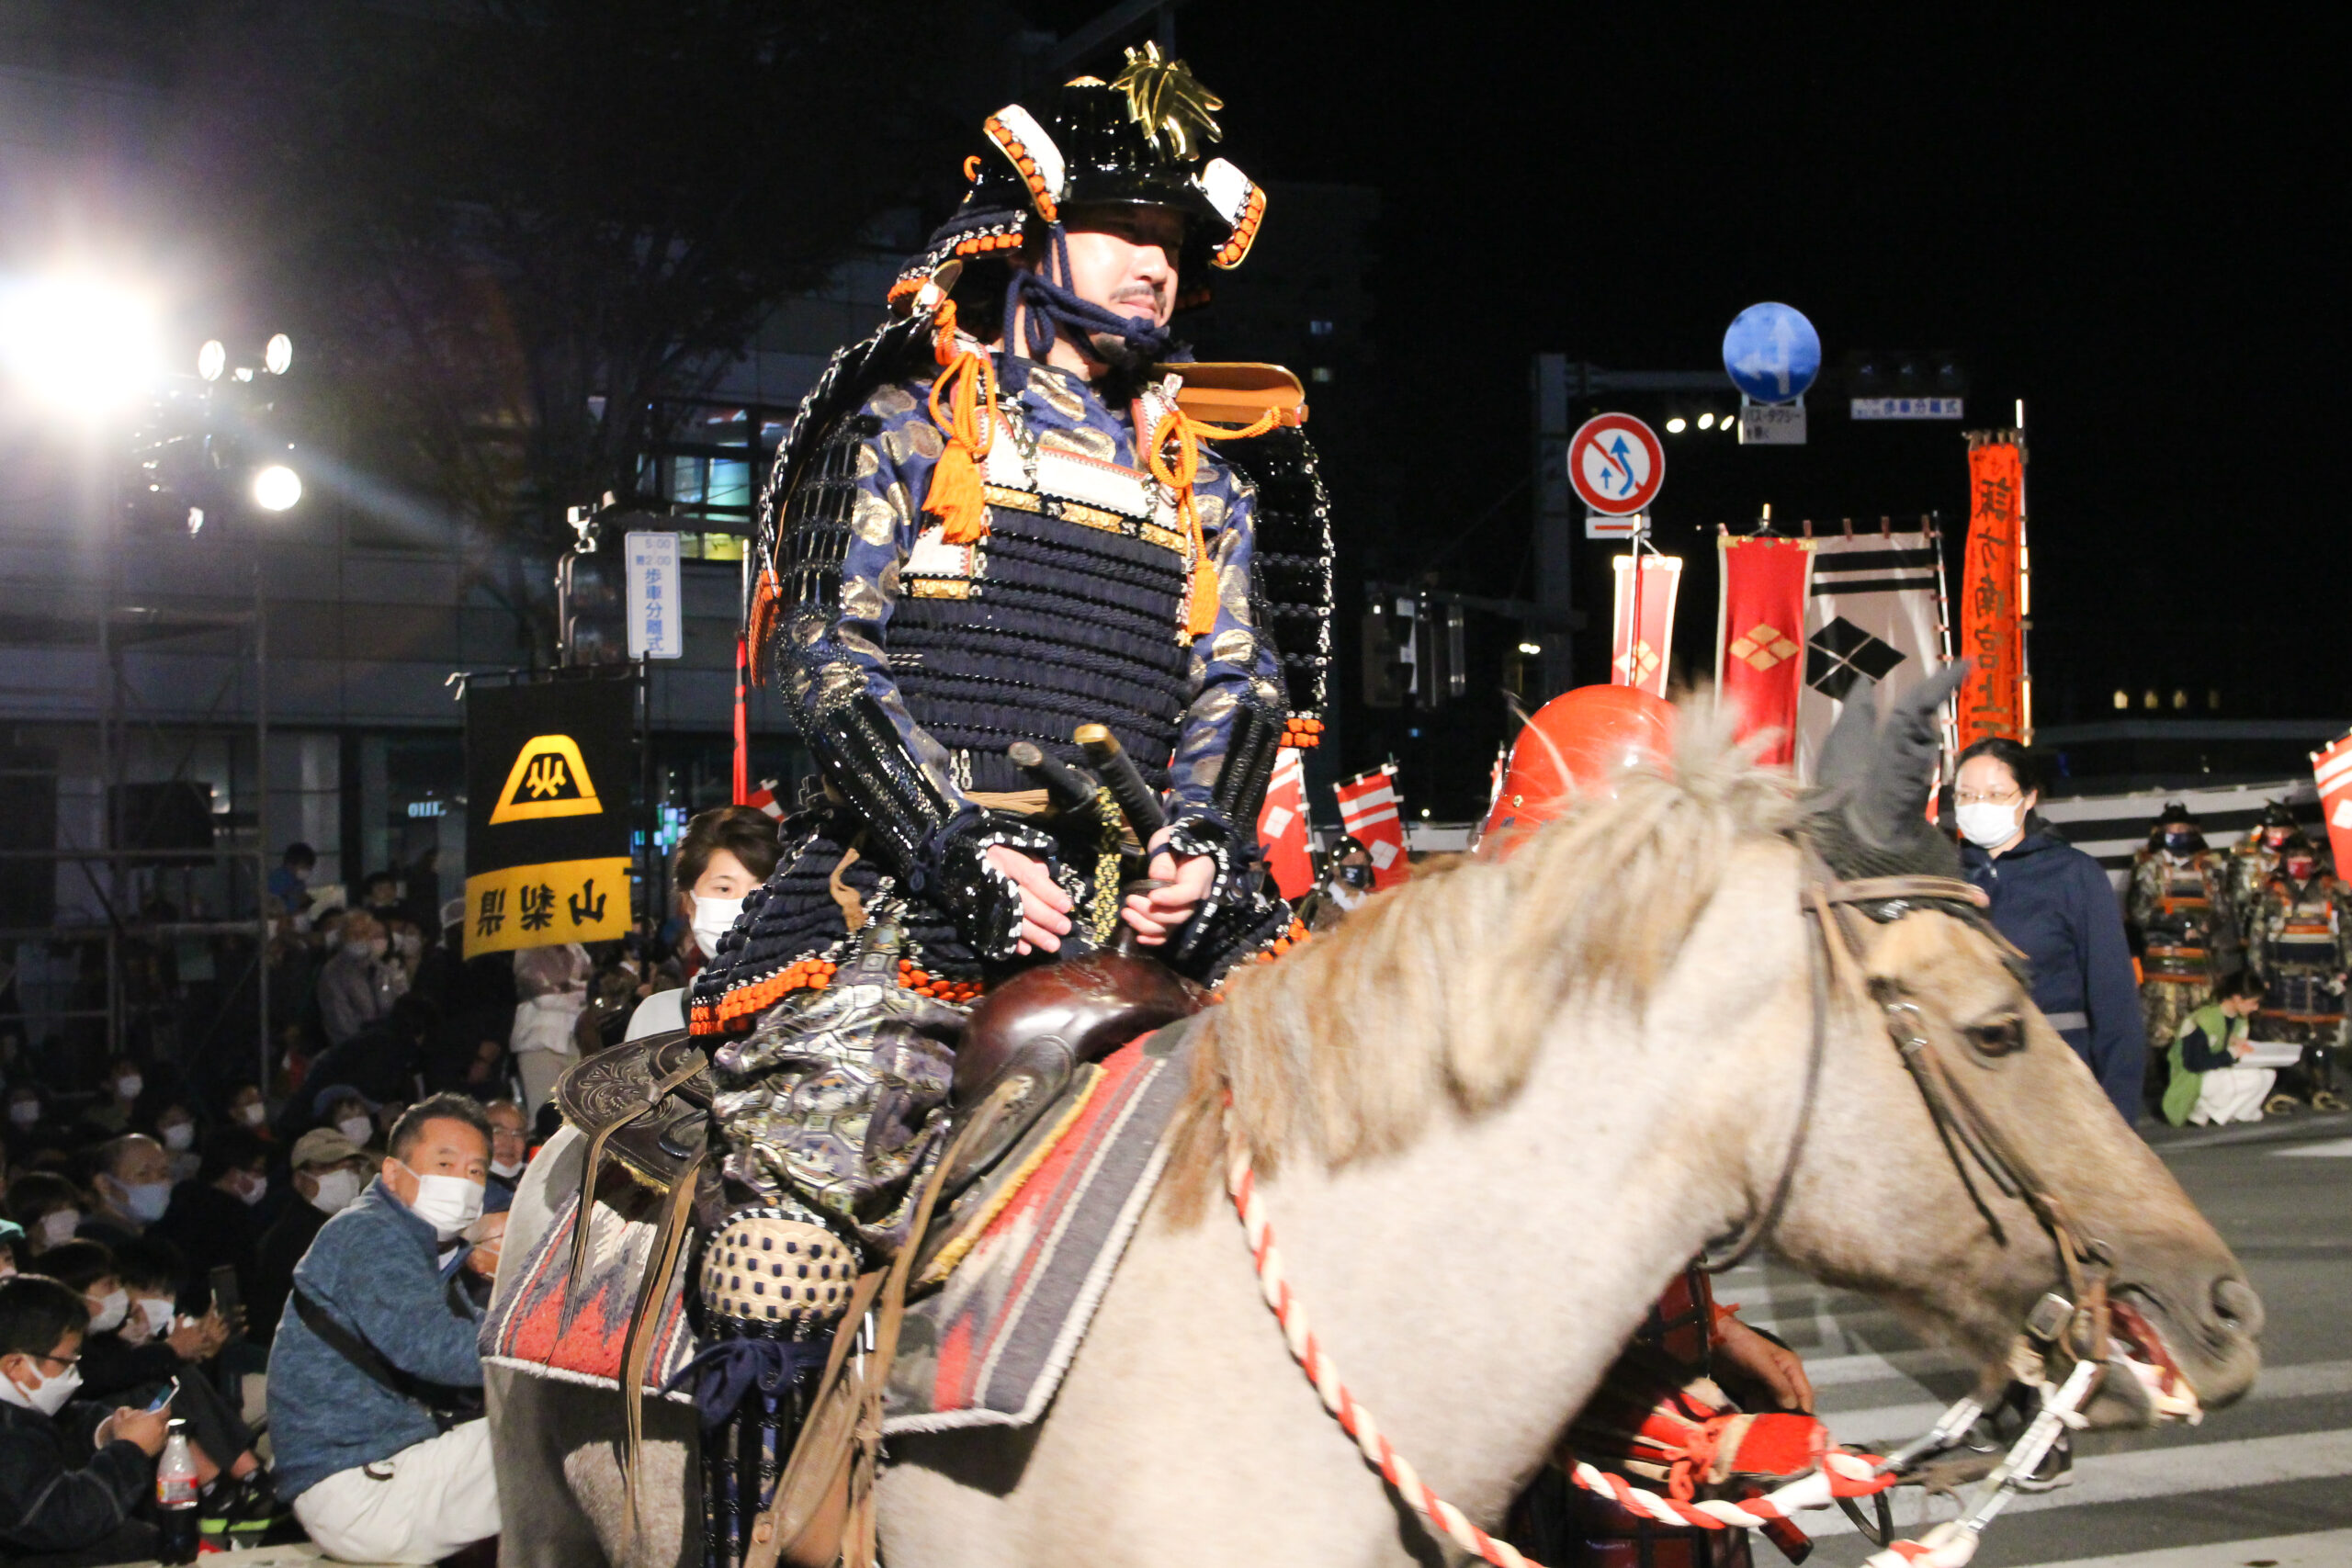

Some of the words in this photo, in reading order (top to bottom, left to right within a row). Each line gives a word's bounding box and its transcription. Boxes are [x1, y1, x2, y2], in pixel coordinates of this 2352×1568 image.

[645, 568, 664, 651] 歩車分離式
